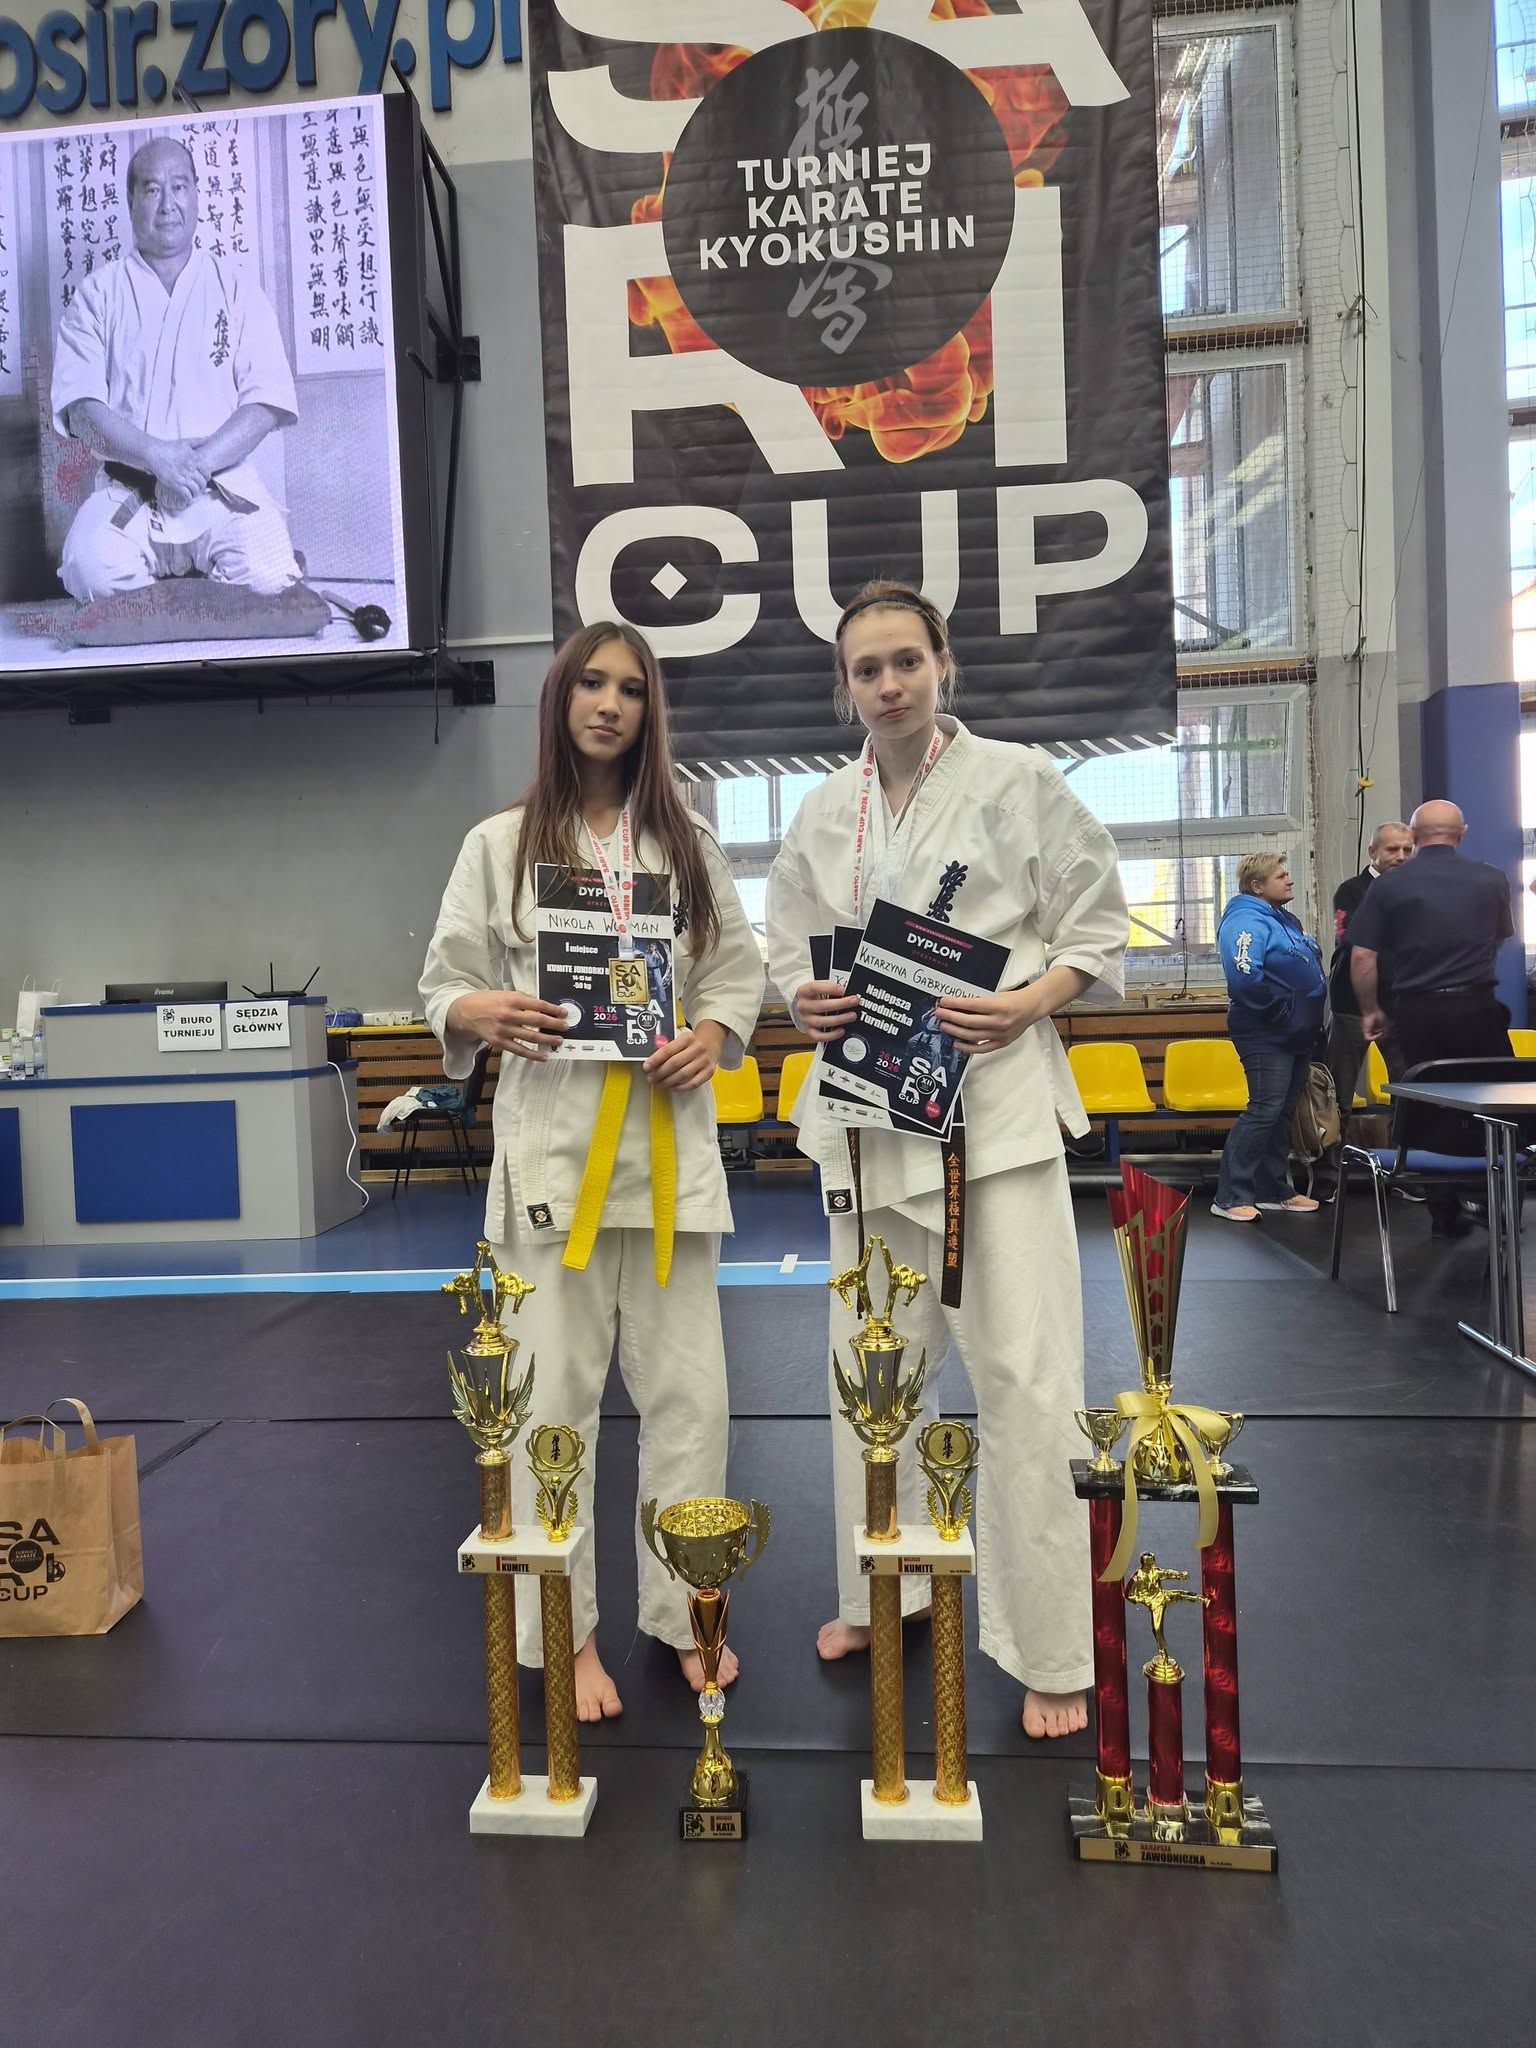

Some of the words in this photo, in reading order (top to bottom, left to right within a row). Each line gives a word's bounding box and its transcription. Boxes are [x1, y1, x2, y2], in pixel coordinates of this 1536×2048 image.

[737, 143, 931, 191] TURNIEJ
[748, 181, 923, 228] KARATE
[700, 215, 975, 270] KYOKUSHIN
[575, 478, 1149, 658] CUP
[858, 818, 866, 833] CUP
[621, 829, 629, 843] CUP
[856, 834, 864, 853] SARI
[548, 913, 595, 931] NIKOLA
[906, 932, 962, 962] DYPLOM
[860, 946, 907, 979] KATARZYNA
[865, 983, 912, 1011] Najlepsza
[180, 1016, 212, 1024] BIURO
[236, 1008, 278, 1019] SĘDZIA
[593, 1013, 618, 1021] 2026
[233, 1022, 283, 1033] GŁÓWNY
[860, 1011, 899, 1036] Turnieju
[163, 1029, 215, 1037] TURNIEJU
[898, 1093, 920, 1105] CUP
[501, 1563, 530, 1572] KUMITE
[904, 1564, 934, 1573] KUMITE
[0, 1585, 48, 1602] CUP
[716, 1823, 736, 1831] KATA
[1140, 1851, 1206, 1865] ZAWODNICZKA
